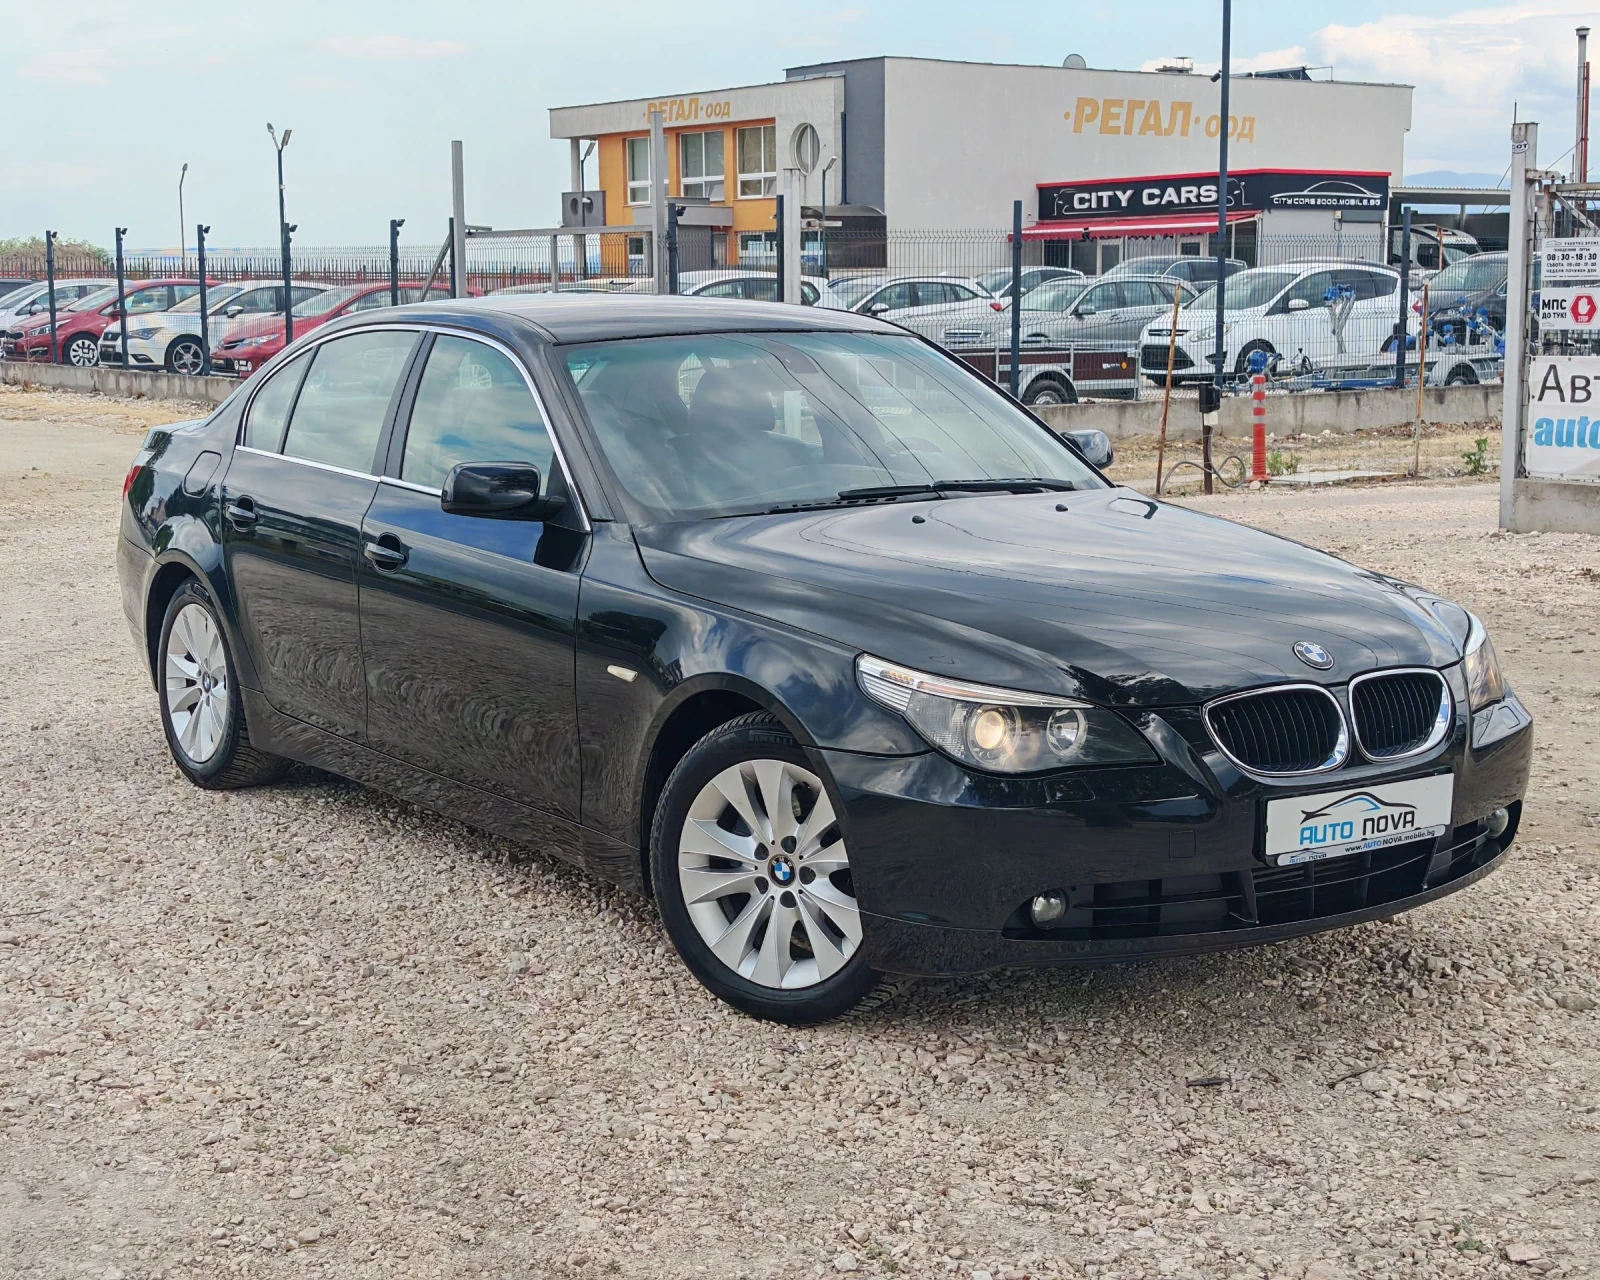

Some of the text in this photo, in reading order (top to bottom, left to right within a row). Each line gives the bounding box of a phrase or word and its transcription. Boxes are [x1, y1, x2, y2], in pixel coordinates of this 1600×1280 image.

[1072, 97, 1193, 137] РЕГАЛ
[1073, 185, 1218, 210] CITY CARS
[1541, 299, 1567, 311] МПС
[1541, 311, 1567, 320] ДО ТУК!
[1537, 364, 1600, 403] Ав
[1300, 810, 1415, 846] AUTO NOVA
